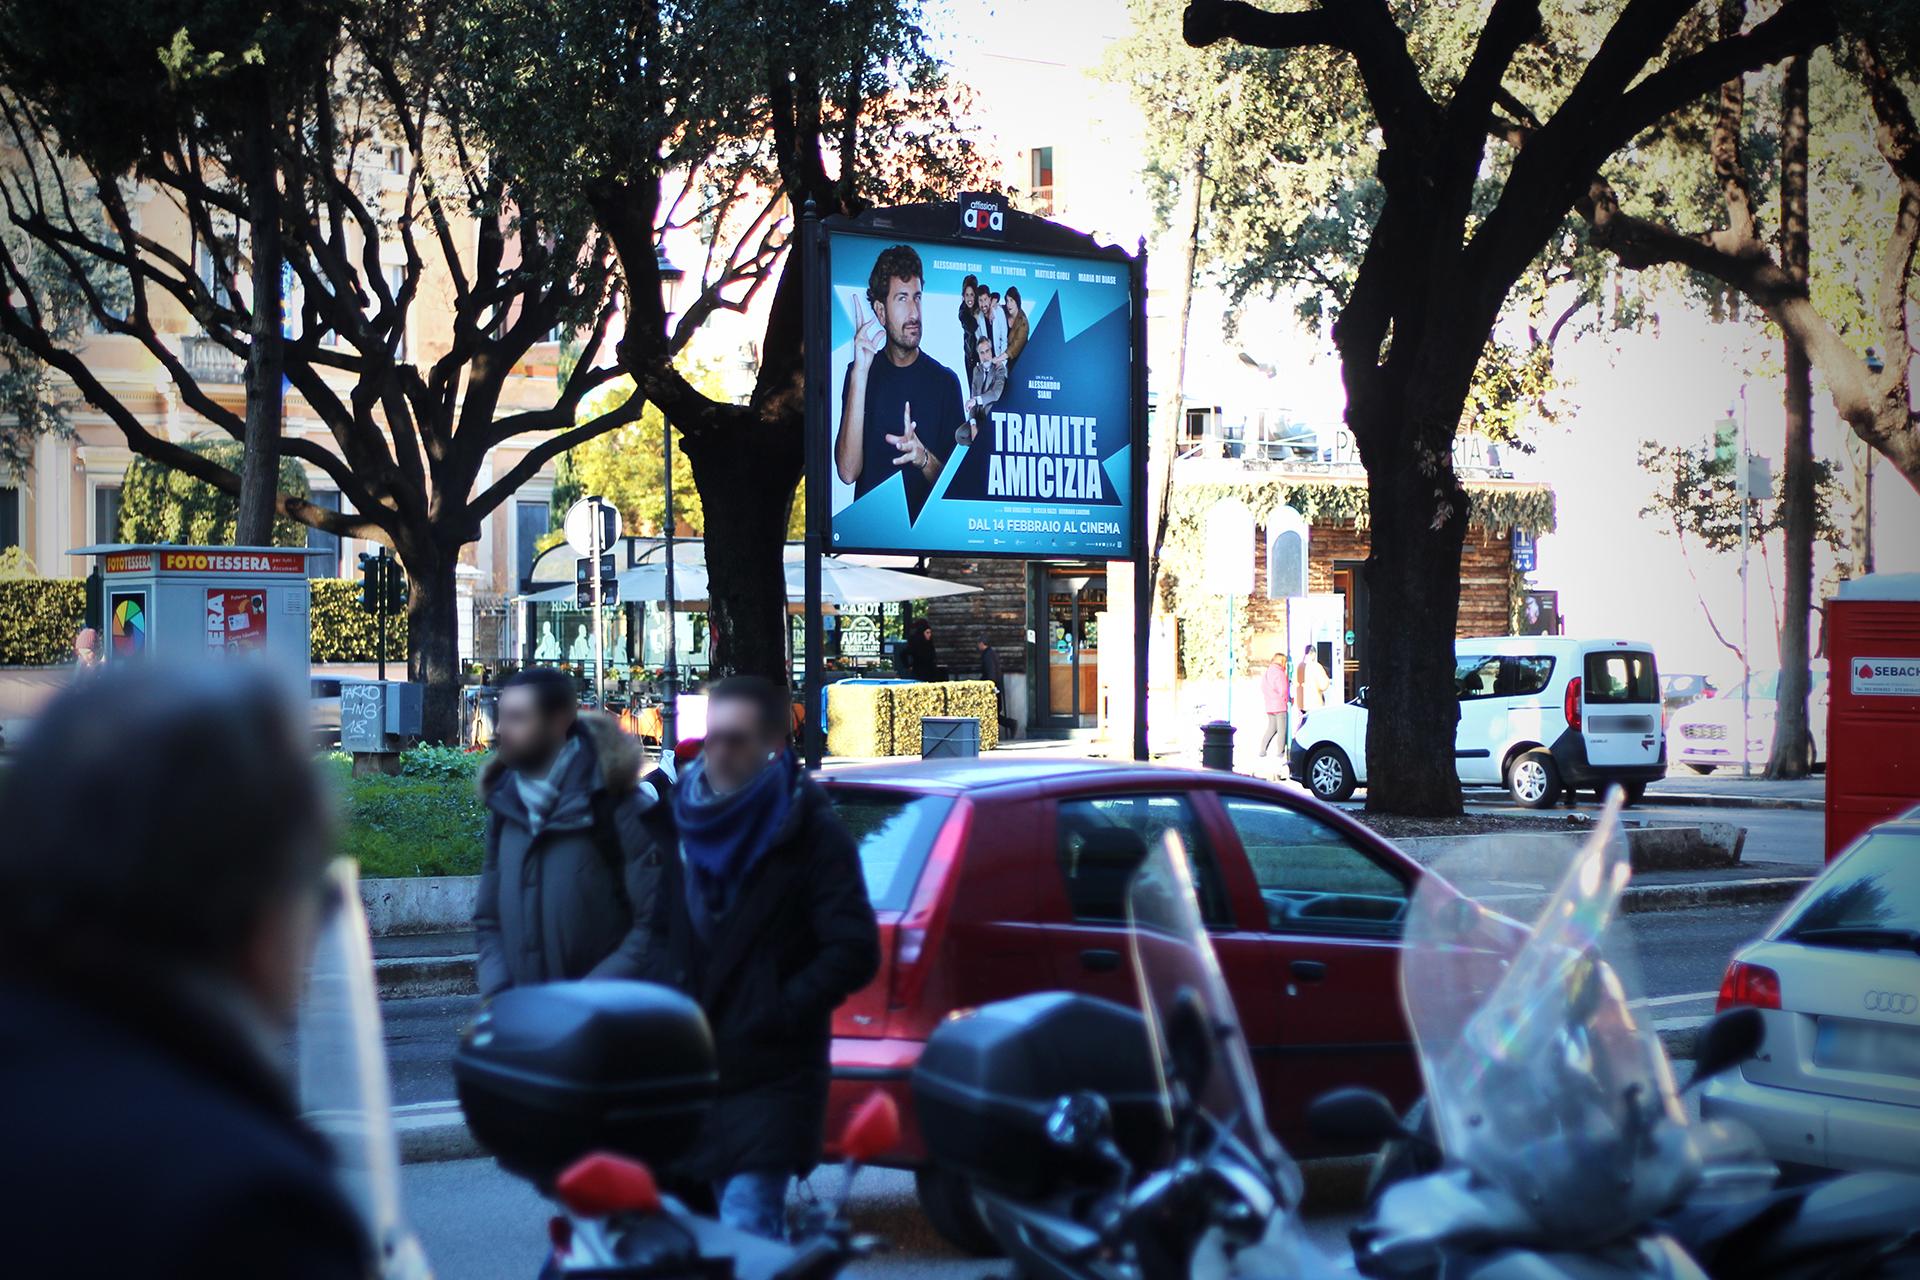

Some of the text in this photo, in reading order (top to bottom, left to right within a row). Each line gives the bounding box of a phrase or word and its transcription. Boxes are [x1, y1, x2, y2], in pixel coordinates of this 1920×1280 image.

[964, 208, 1004, 231] apa
[933, 260, 967, 271] ALESSANDRO
[1028, 380, 1061, 390] ALESSANDRO
[991, 411, 1098, 457] TRAMITE
[987, 455, 1103, 499] AMICIZIA
[968, 518, 1122, 535] DAL 14 FEBBRAIO AL CINEMA
[107, 555, 152, 572] FOTOTESSERA
[167, 555, 272, 572] FOTOTESSERA
